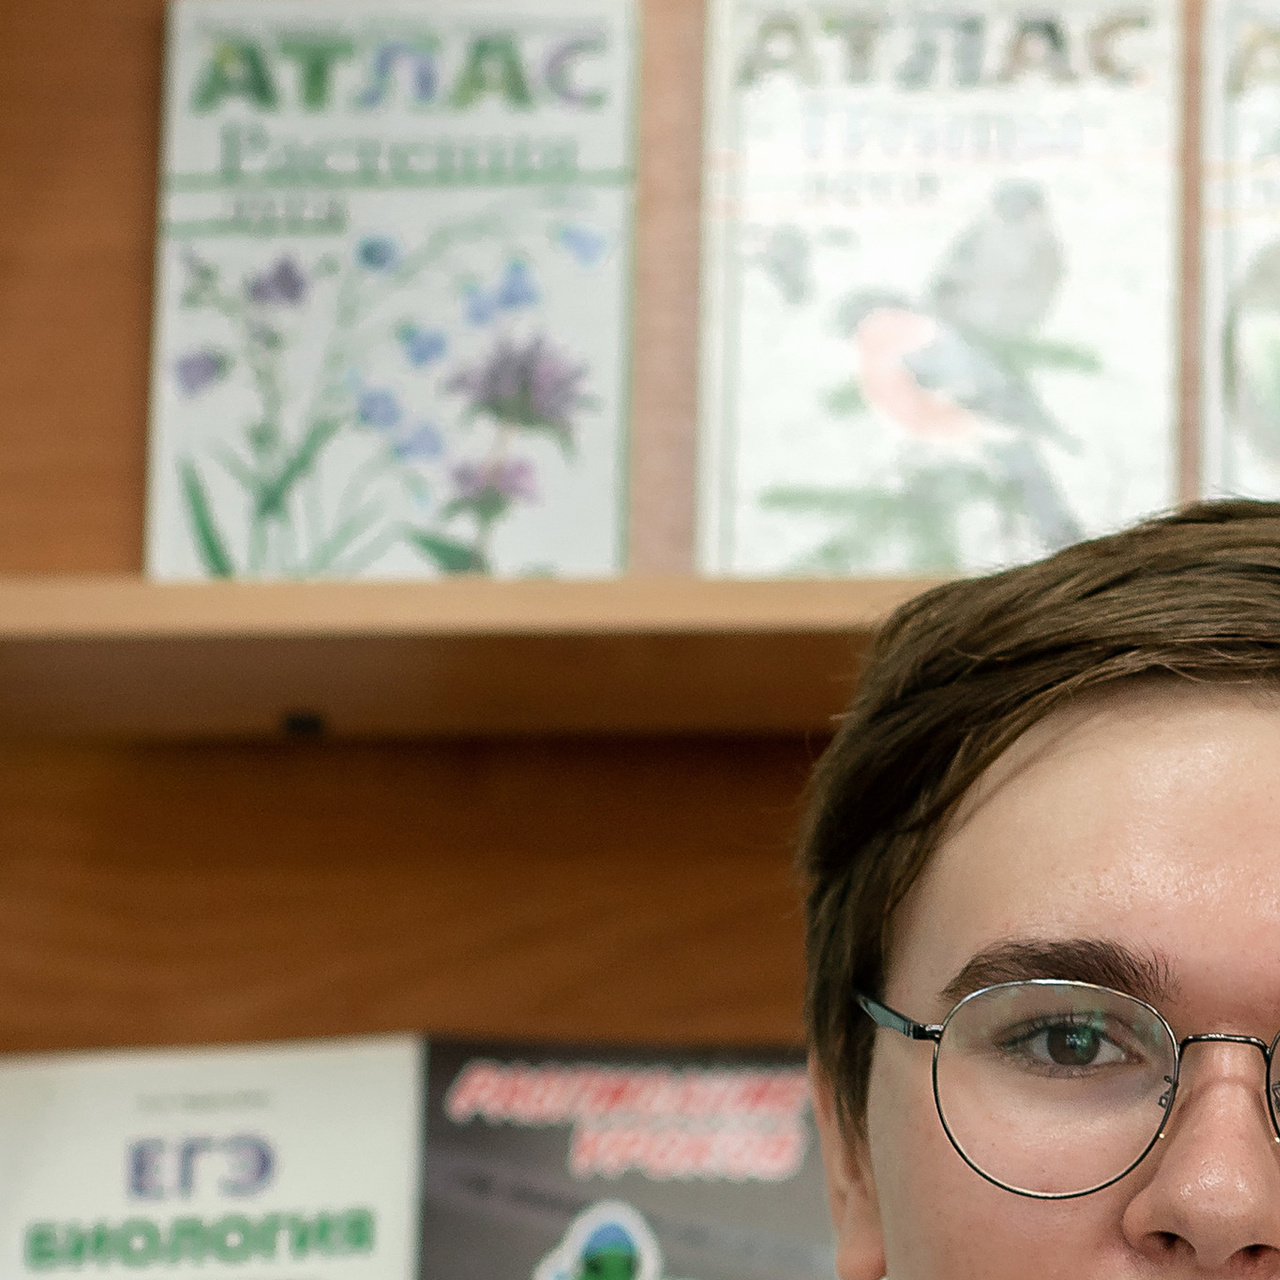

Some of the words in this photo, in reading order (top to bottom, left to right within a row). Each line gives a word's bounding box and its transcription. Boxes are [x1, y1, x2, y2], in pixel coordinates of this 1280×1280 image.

[190, 34, 606, 110] АТЛАС
[736, 14, 1152, 88] АТЛАС
[128, 1136, 276, 1200] ЕГЭ
[26, 1208, 374, 1272] БИОЛОГИЯ
